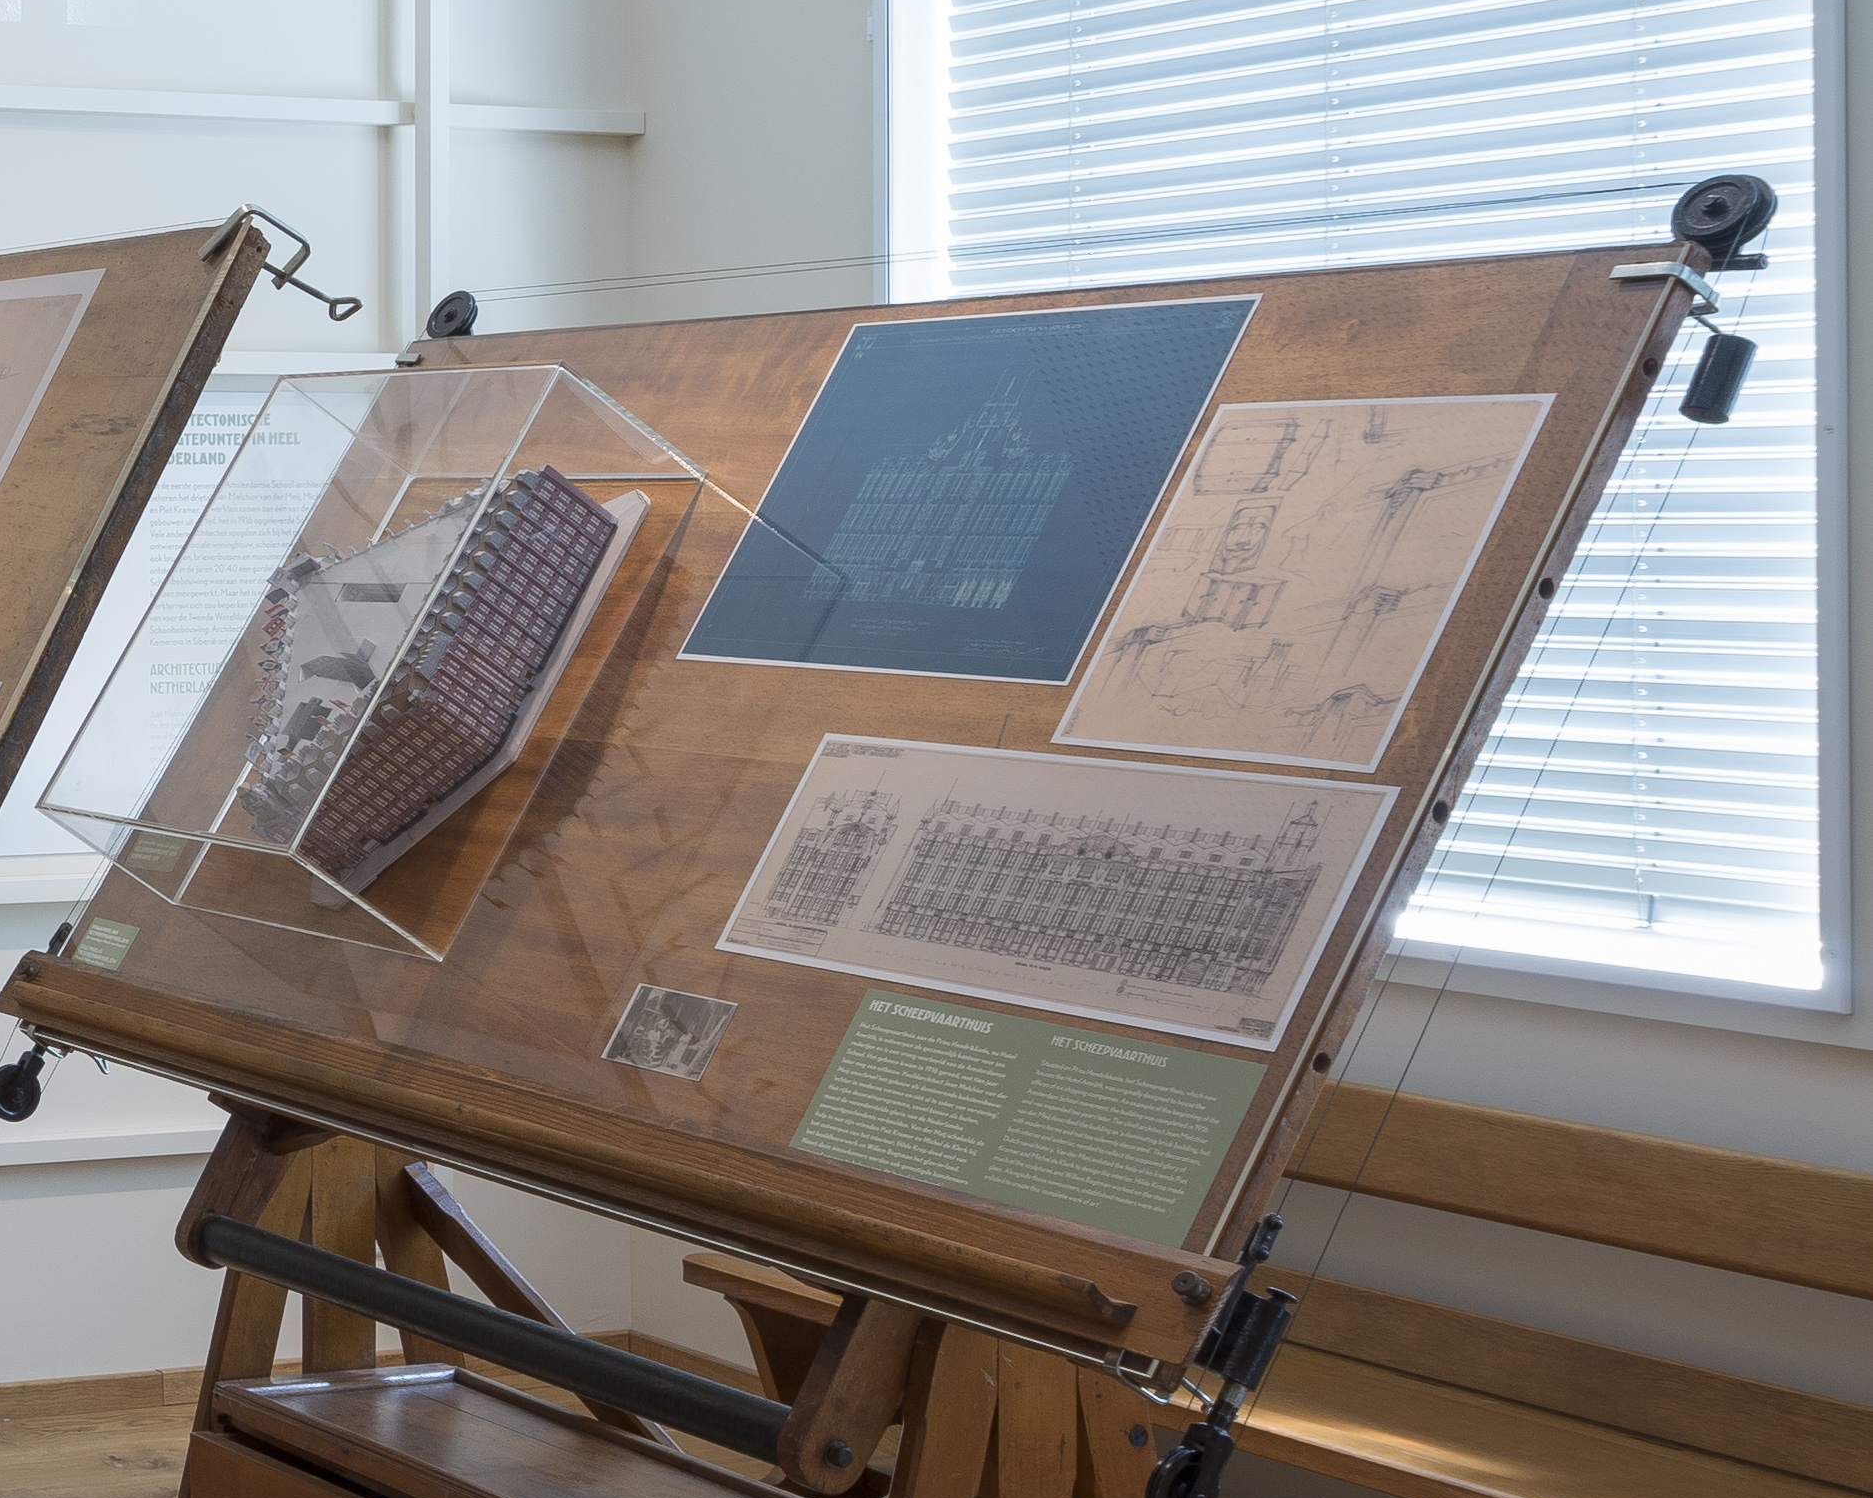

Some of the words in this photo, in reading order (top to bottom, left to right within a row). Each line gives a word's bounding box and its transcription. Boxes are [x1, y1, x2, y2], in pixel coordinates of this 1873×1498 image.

[268, 432, 300, 445] HEEL
[869, 999, 892, 1014] HET
[892, 1002, 994, 1035] SCHEEPVAARTHUIS
[1050, 1035, 1072, 1048] HET
[1072, 1039, 1169, 1068] SCHEEPVAARTHUIS
